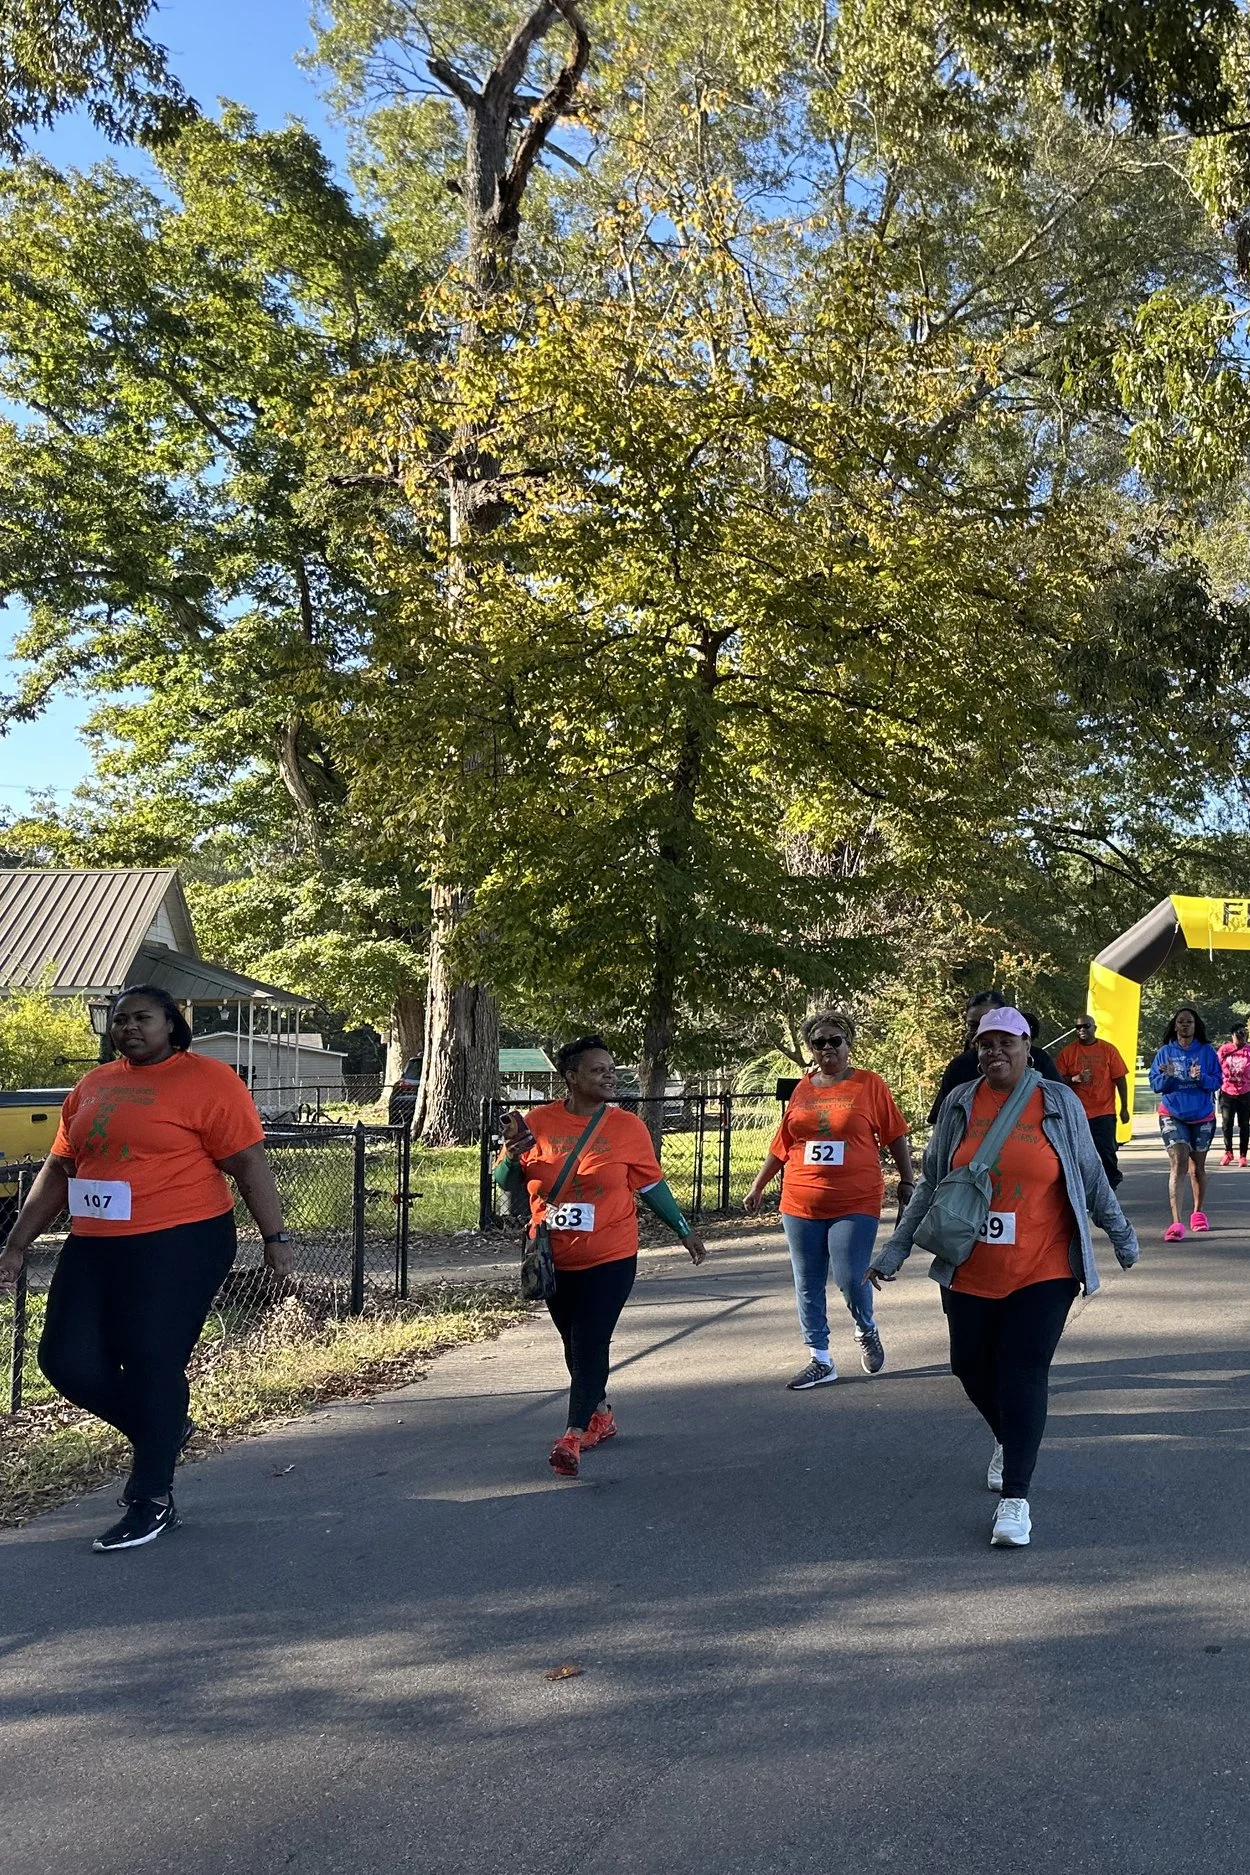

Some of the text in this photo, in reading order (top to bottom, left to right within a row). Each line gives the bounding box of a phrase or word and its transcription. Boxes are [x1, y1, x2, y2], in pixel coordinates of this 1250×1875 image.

[811, 1145, 834, 1162] 52
[84, 1194, 112, 1209] 107
[554, 1208, 583, 1227] 63
